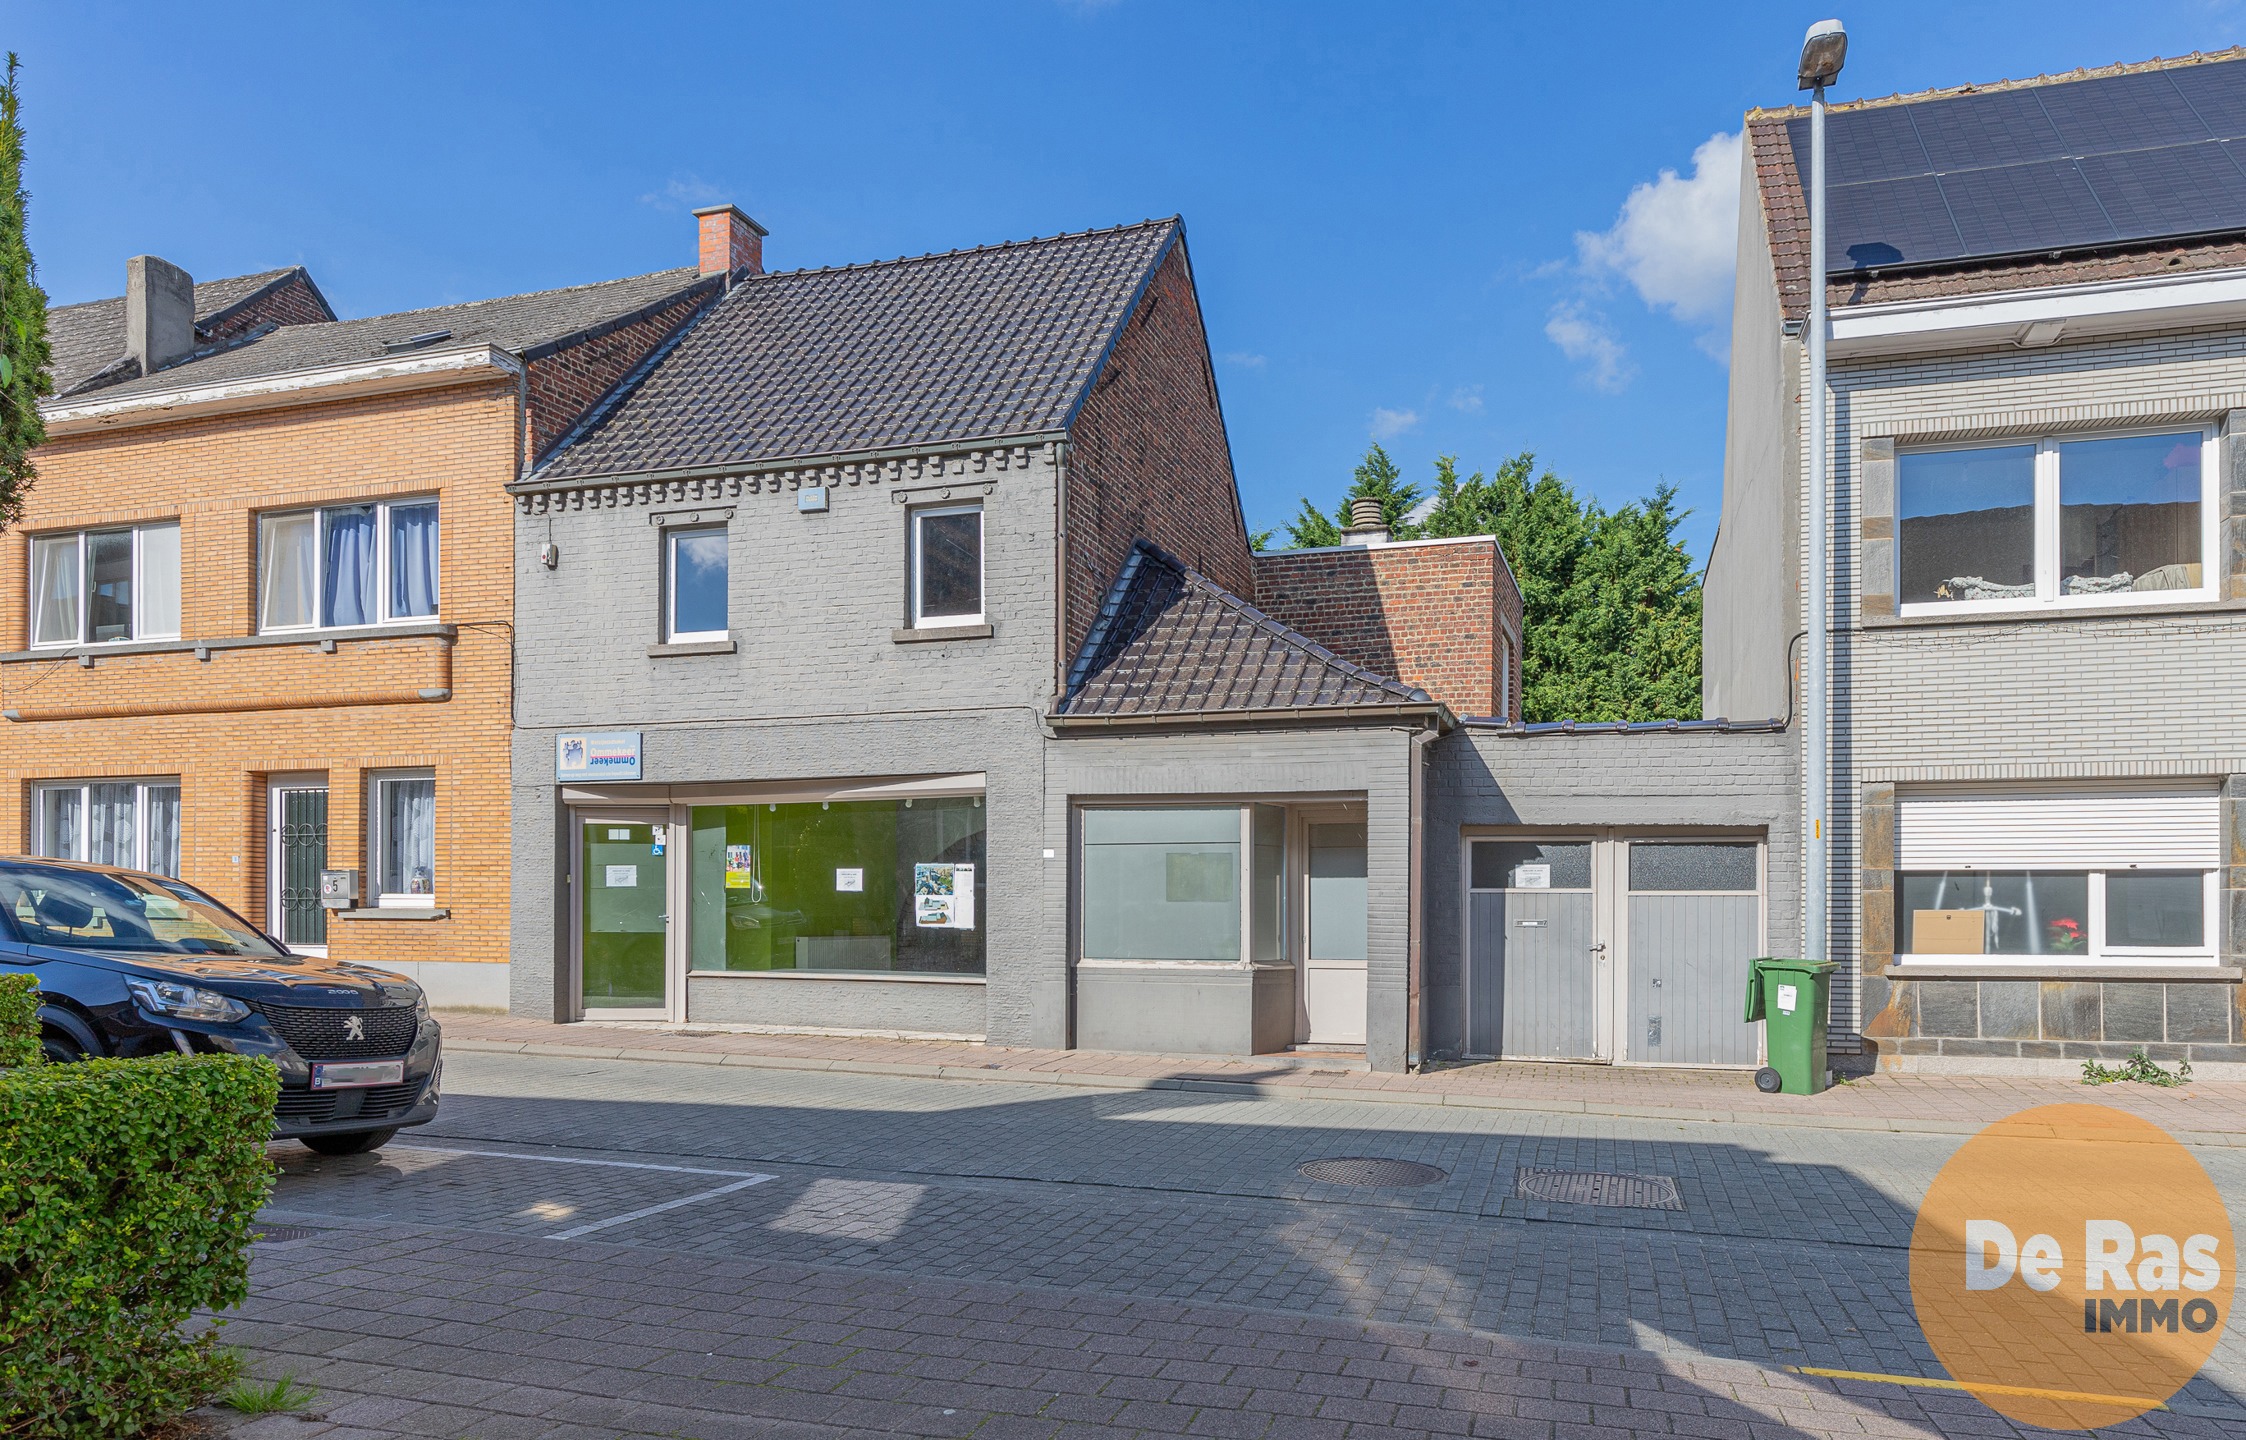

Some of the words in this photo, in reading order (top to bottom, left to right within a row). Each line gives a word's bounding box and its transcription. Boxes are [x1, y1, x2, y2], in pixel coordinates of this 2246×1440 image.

[590, 747, 636, 757] Ommekeer
[590, 756, 636, 767] Ommekeer
[332, 880, 338, 892] 5
[314, 1077, 321, 1085] B
